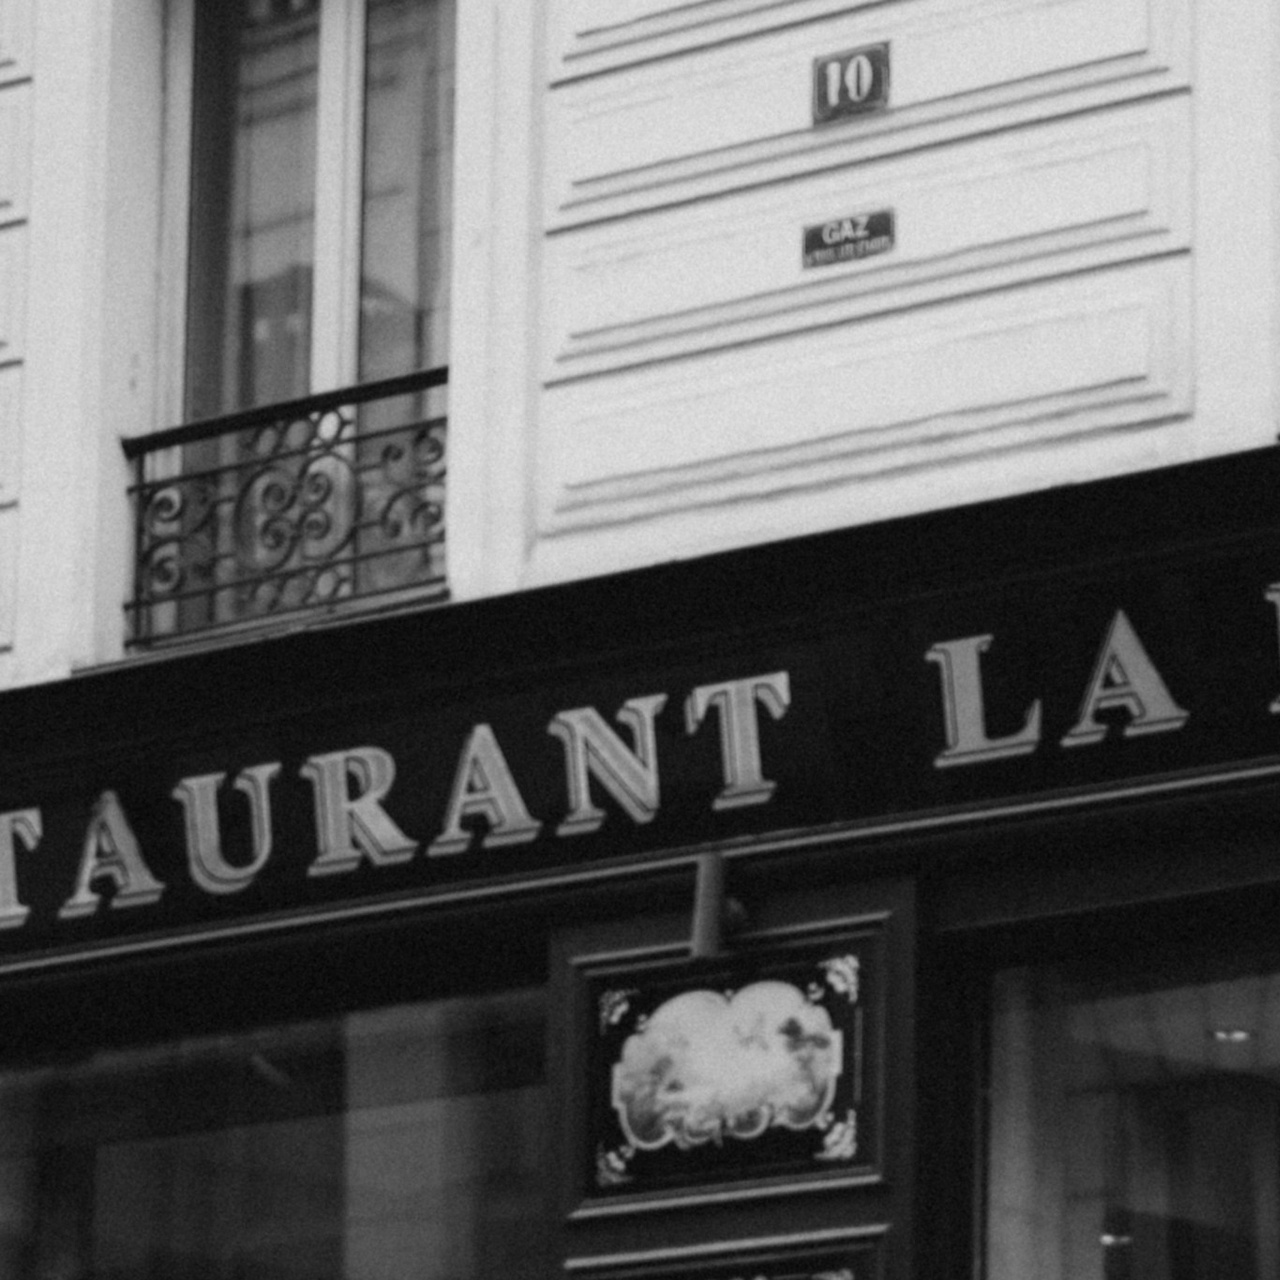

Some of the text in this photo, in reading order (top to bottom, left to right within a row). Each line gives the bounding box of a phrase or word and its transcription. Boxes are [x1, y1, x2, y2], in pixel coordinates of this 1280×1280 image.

[825, 54, 874, 107] 10
[821, 215, 871, 245] GAZ
[925, 609, 1189, 768] LA
